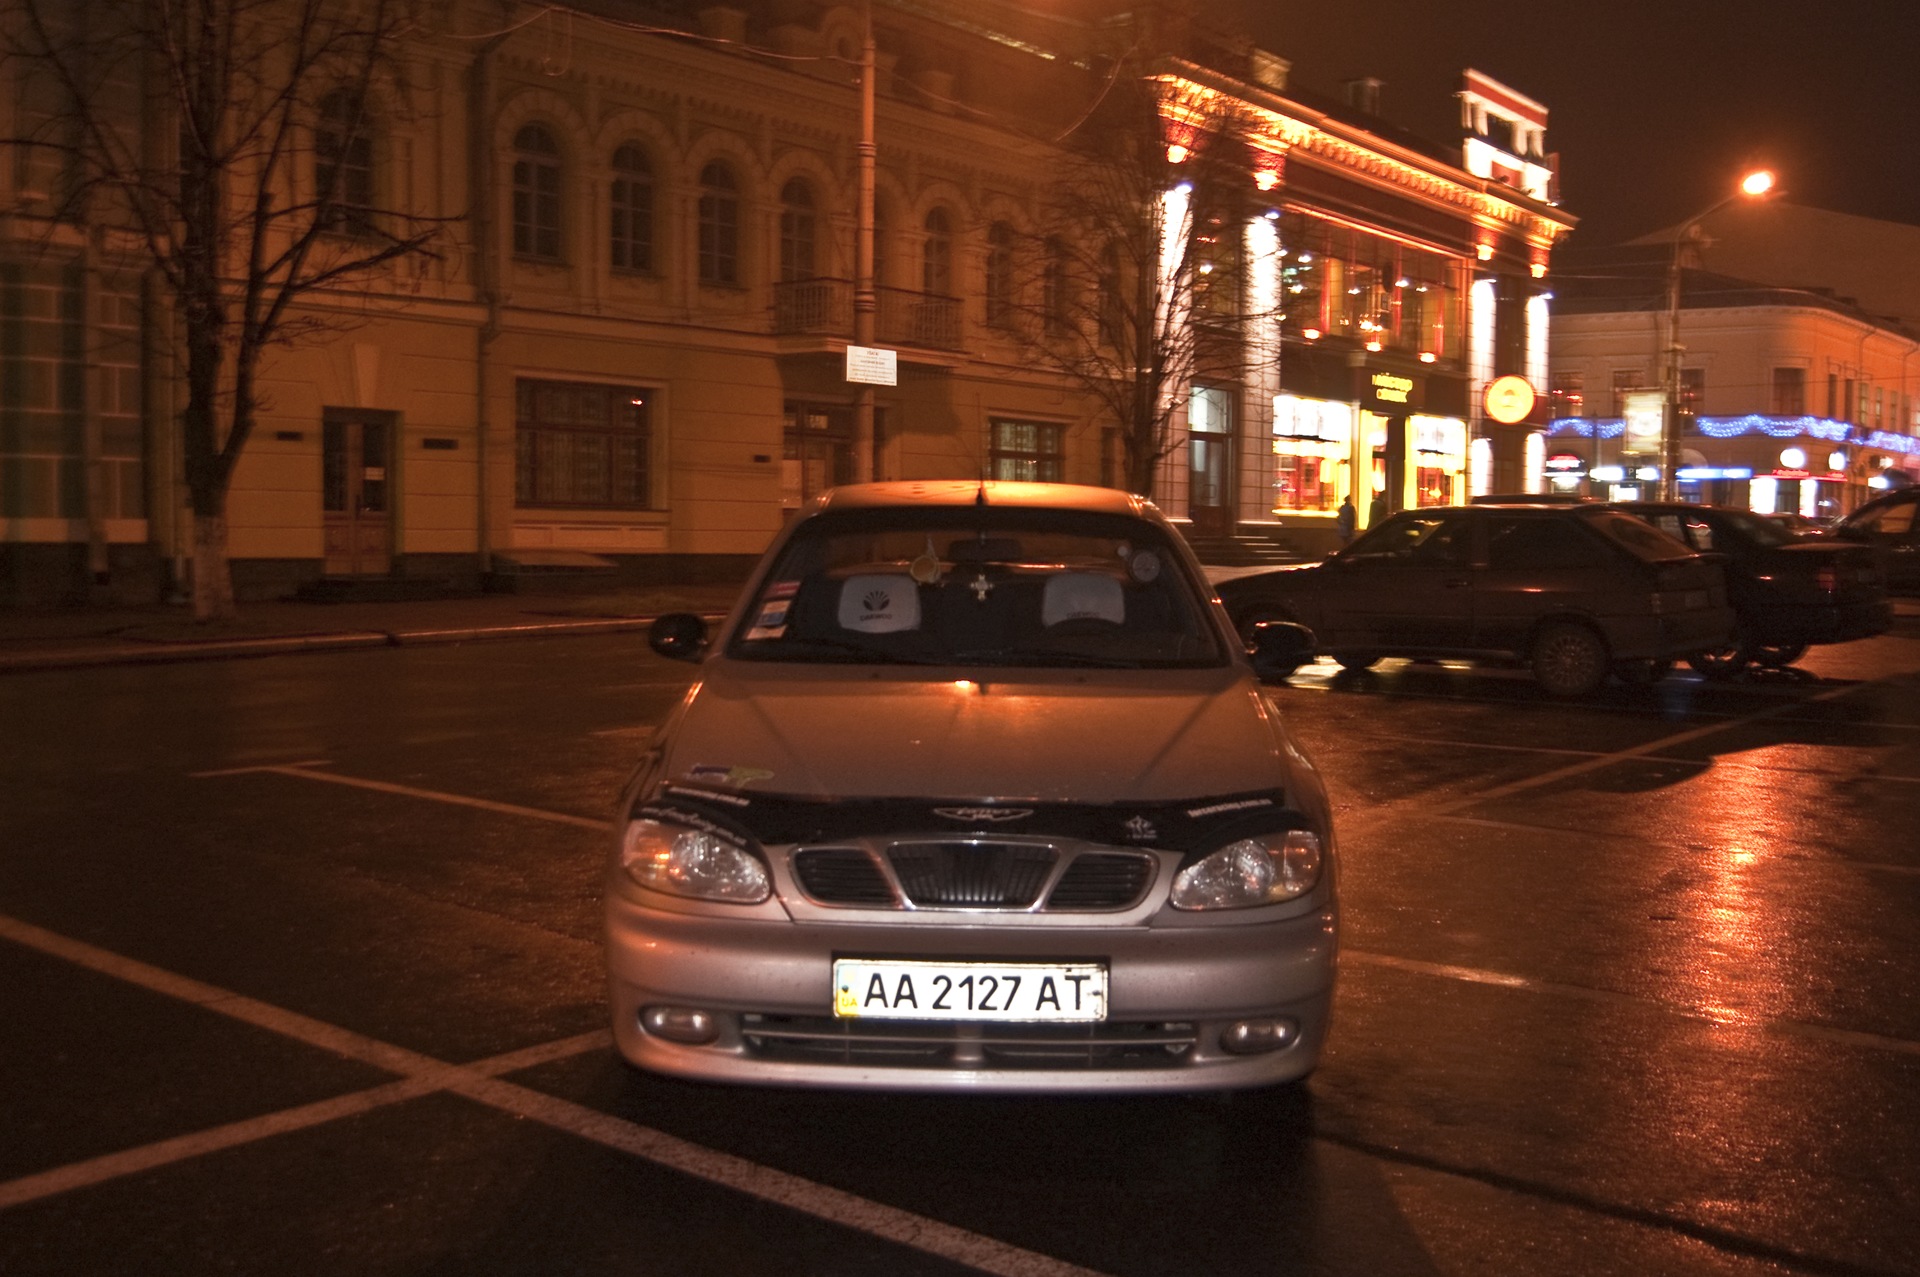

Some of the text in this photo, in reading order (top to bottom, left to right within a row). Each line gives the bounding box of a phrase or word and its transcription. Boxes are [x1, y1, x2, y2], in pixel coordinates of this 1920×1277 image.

[860, 613, 893, 621] DAEWOO
[864, 972, 1091, 1011] AA 2127 AT
[841, 998, 858, 1007] UA
